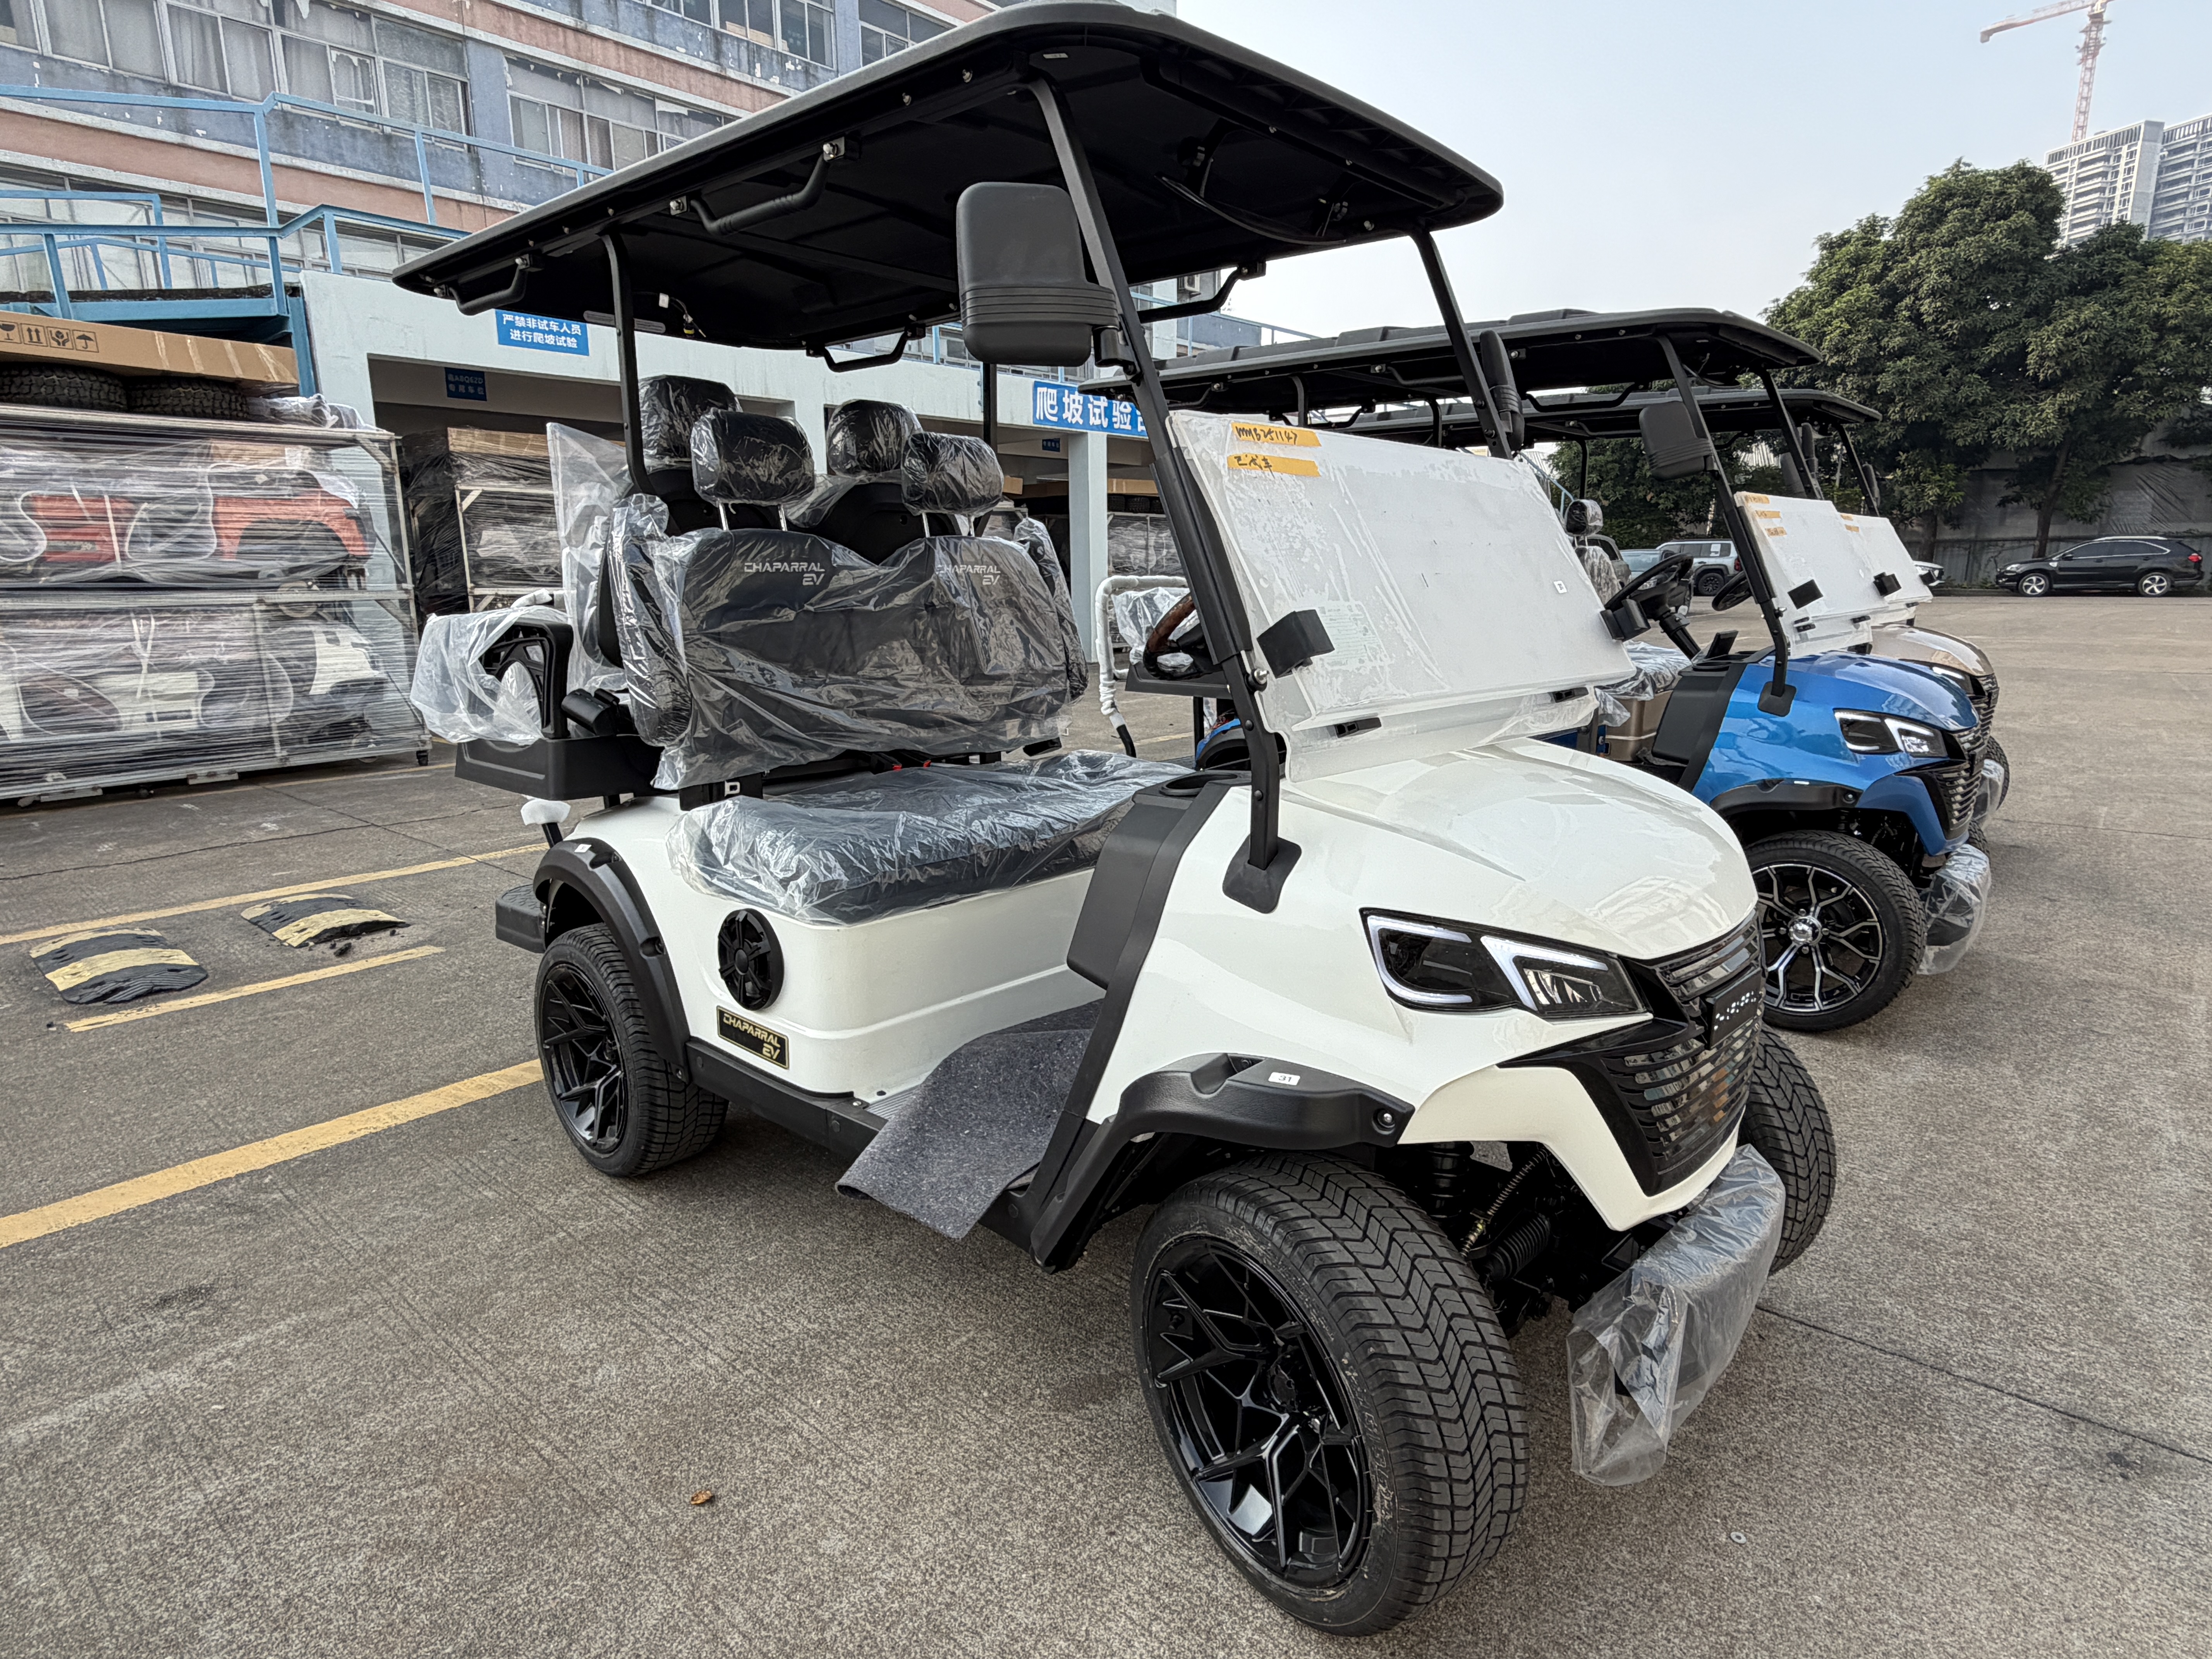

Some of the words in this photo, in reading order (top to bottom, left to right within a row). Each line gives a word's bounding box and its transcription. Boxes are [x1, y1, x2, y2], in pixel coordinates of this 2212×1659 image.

[502, 314, 582, 335] 严禁非试车人员
[510, 329, 578, 349] 进行爬坡试验
[744, 562, 825, 572] CHAPARRAL
[936, 564, 1001, 574] CHAPARRAL
[802, 573, 825, 586] EV
[982, 575, 1000, 586] EV
[723, 1013, 781, 1048] CHAPARRAL
[762, 1043, 781, 1060] EV
